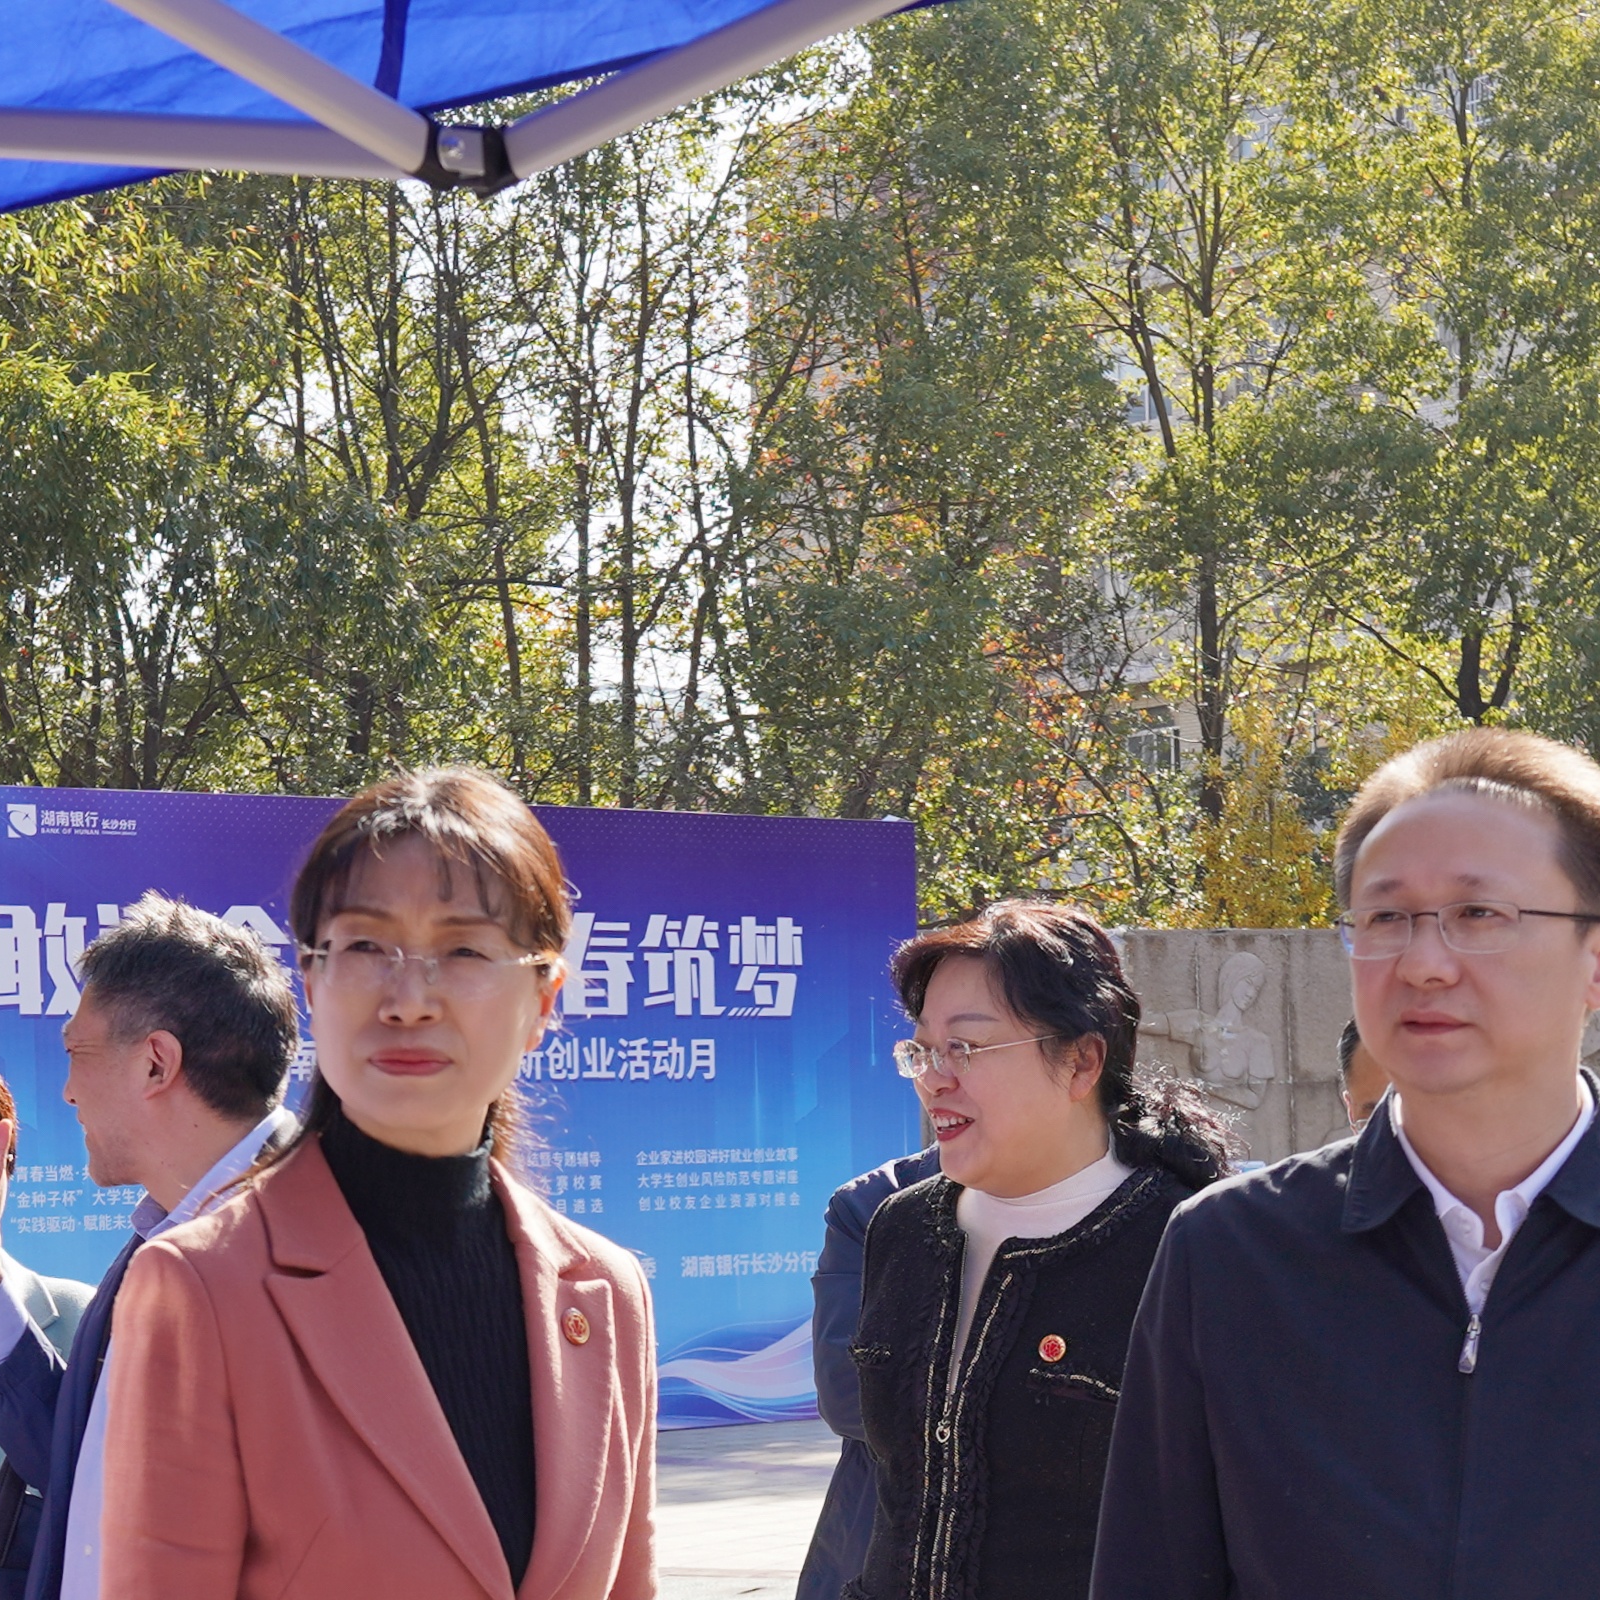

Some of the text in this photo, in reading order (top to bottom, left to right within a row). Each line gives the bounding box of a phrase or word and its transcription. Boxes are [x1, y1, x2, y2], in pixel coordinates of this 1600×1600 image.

[41, 810, 137, 830] 湖南银行 长沙分行
[562, 912, 803, 1018] 春筑梦
[9, 1164, 91, 1183] 青春当燃·
[637, 1170, 799, 1189] 大学生创业风险防范专题讲座
[638, 1192, 800, 1212] 创业校友企业资源对接会
[681, 1251, 817, 1278] 湖南银行长沙分行
